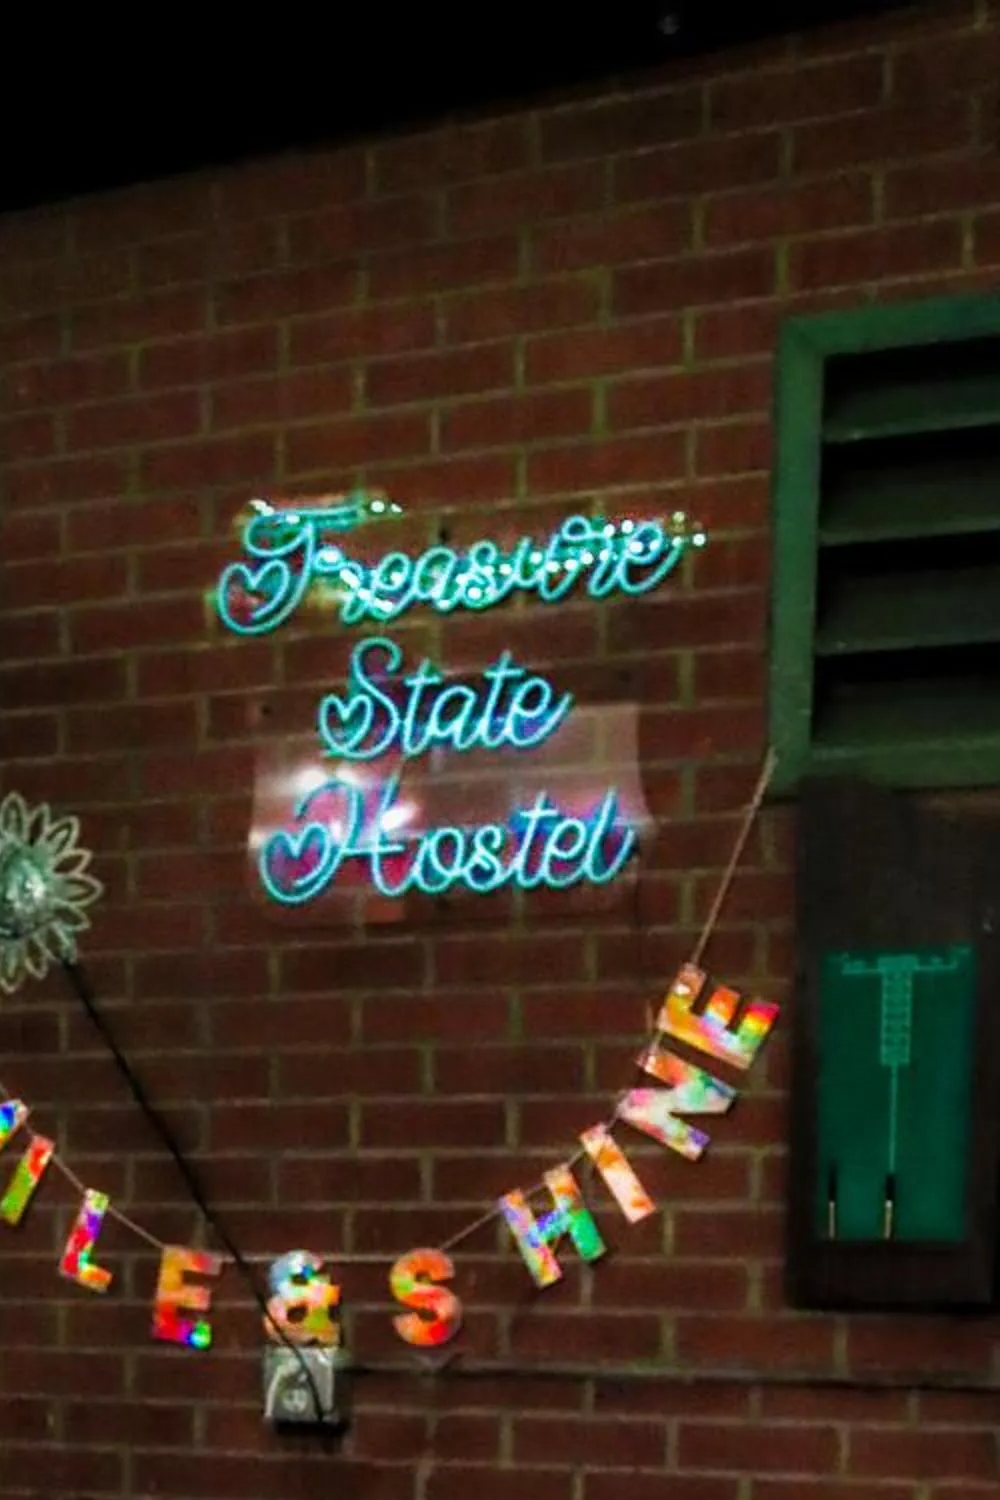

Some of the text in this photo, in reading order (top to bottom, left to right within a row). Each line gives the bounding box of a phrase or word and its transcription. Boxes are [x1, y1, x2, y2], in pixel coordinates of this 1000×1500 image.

[217, 502, 685, 635] Treasure
[318, 637, 574, 759] State
[259, 774, 635, 905] Hostel
[389, 962, 780, 1347] SHINE
